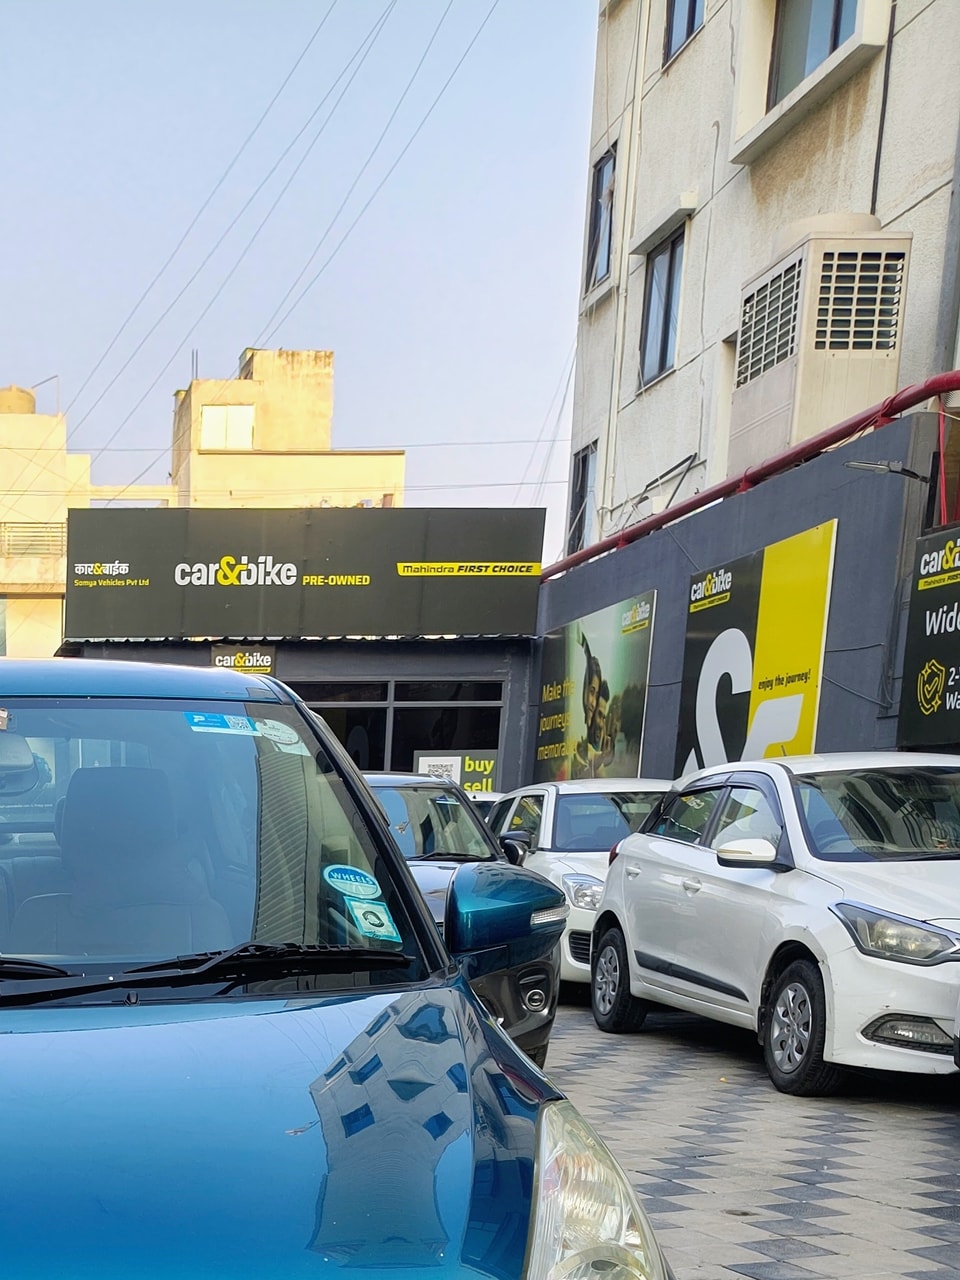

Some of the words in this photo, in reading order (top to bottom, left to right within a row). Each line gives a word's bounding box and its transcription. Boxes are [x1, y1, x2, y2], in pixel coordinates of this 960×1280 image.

[175, 555, 297, 586] car&bike
[402, 564, 454, 574] Mahindra
[456, 564, 490, 574] FIRST
[491, 564, 533, 574] CHOICE
[74, 579, 97, 588] Somya
[98, 578, 125, 587] Vehicles
[126, 578, 138, 587] Pvt
[139, 578, 150, 587] Ltd
[302, 575, 370, 586] PRE-OWNED
[690, 568, 732, 602] car&bike
[215, 651, 272, 668] car&bike
[757, 677, 773, 691] enjoy
[774, 672, 785, 686] the
[785, 668, 811, 685] journey!
[542, 680, 562, 704] Make
[464, 756, 494, 774] buy
[463, 778, 492, 792] sell
[330, 871, 373, 885] WHEELS
